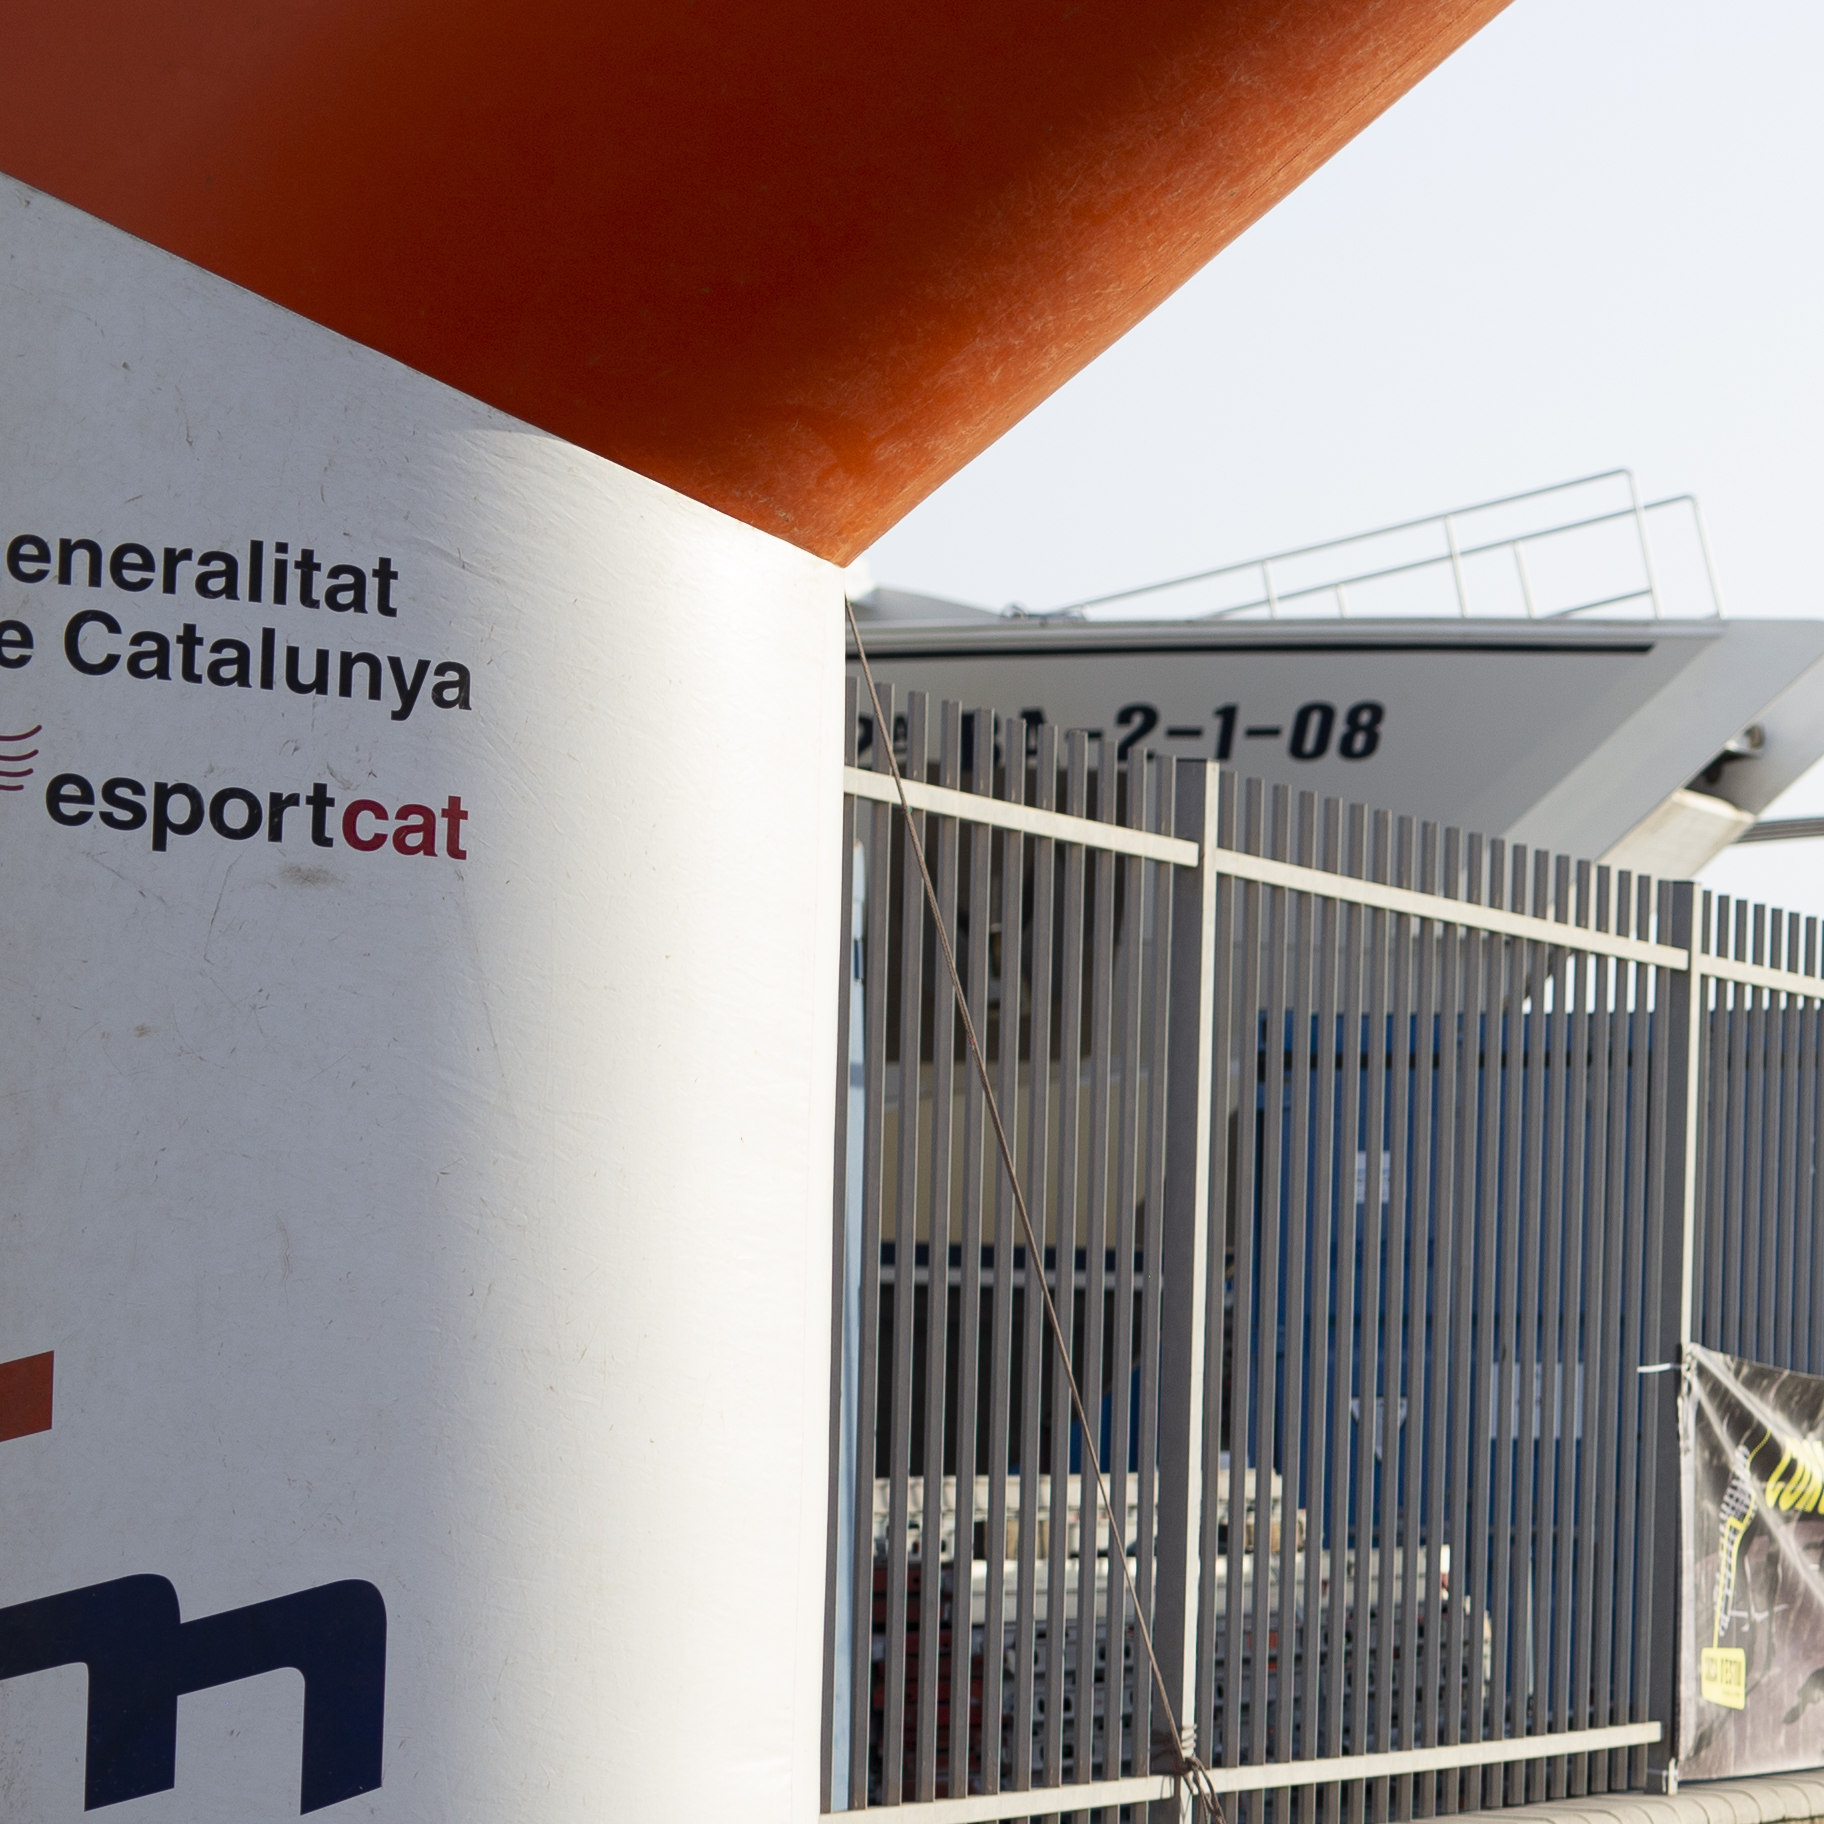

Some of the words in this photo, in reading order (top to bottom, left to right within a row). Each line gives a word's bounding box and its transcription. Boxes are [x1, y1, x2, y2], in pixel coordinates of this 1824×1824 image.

[6, 533, 399, 618] eneralitat
[63, 609, 472, 722] Catalunya
[45, 772, 469, 861] esportcat
